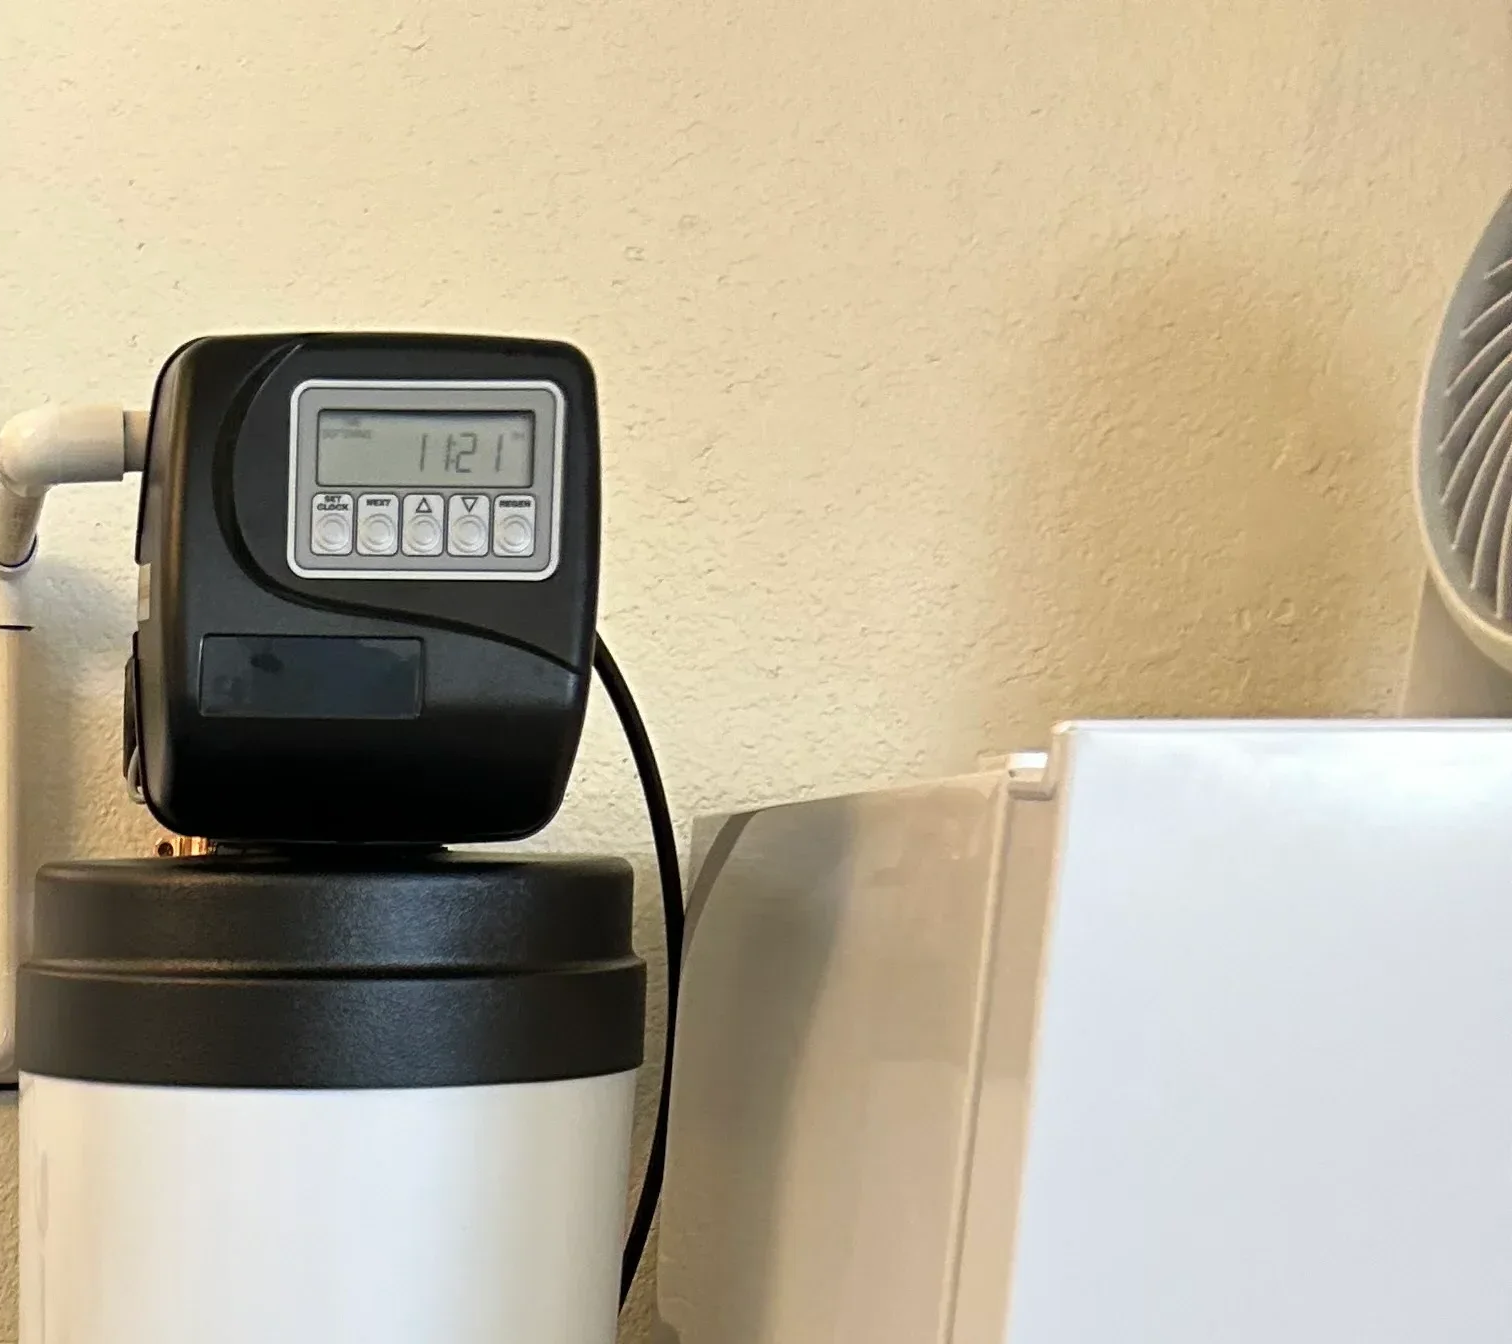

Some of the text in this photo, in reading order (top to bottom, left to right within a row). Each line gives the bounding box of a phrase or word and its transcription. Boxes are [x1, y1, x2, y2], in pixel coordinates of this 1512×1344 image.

[317, 503, 348, 511] CLOCK
[366, 499, 391, 507] NEXT
[498, 500, 531, 508] REGEN
